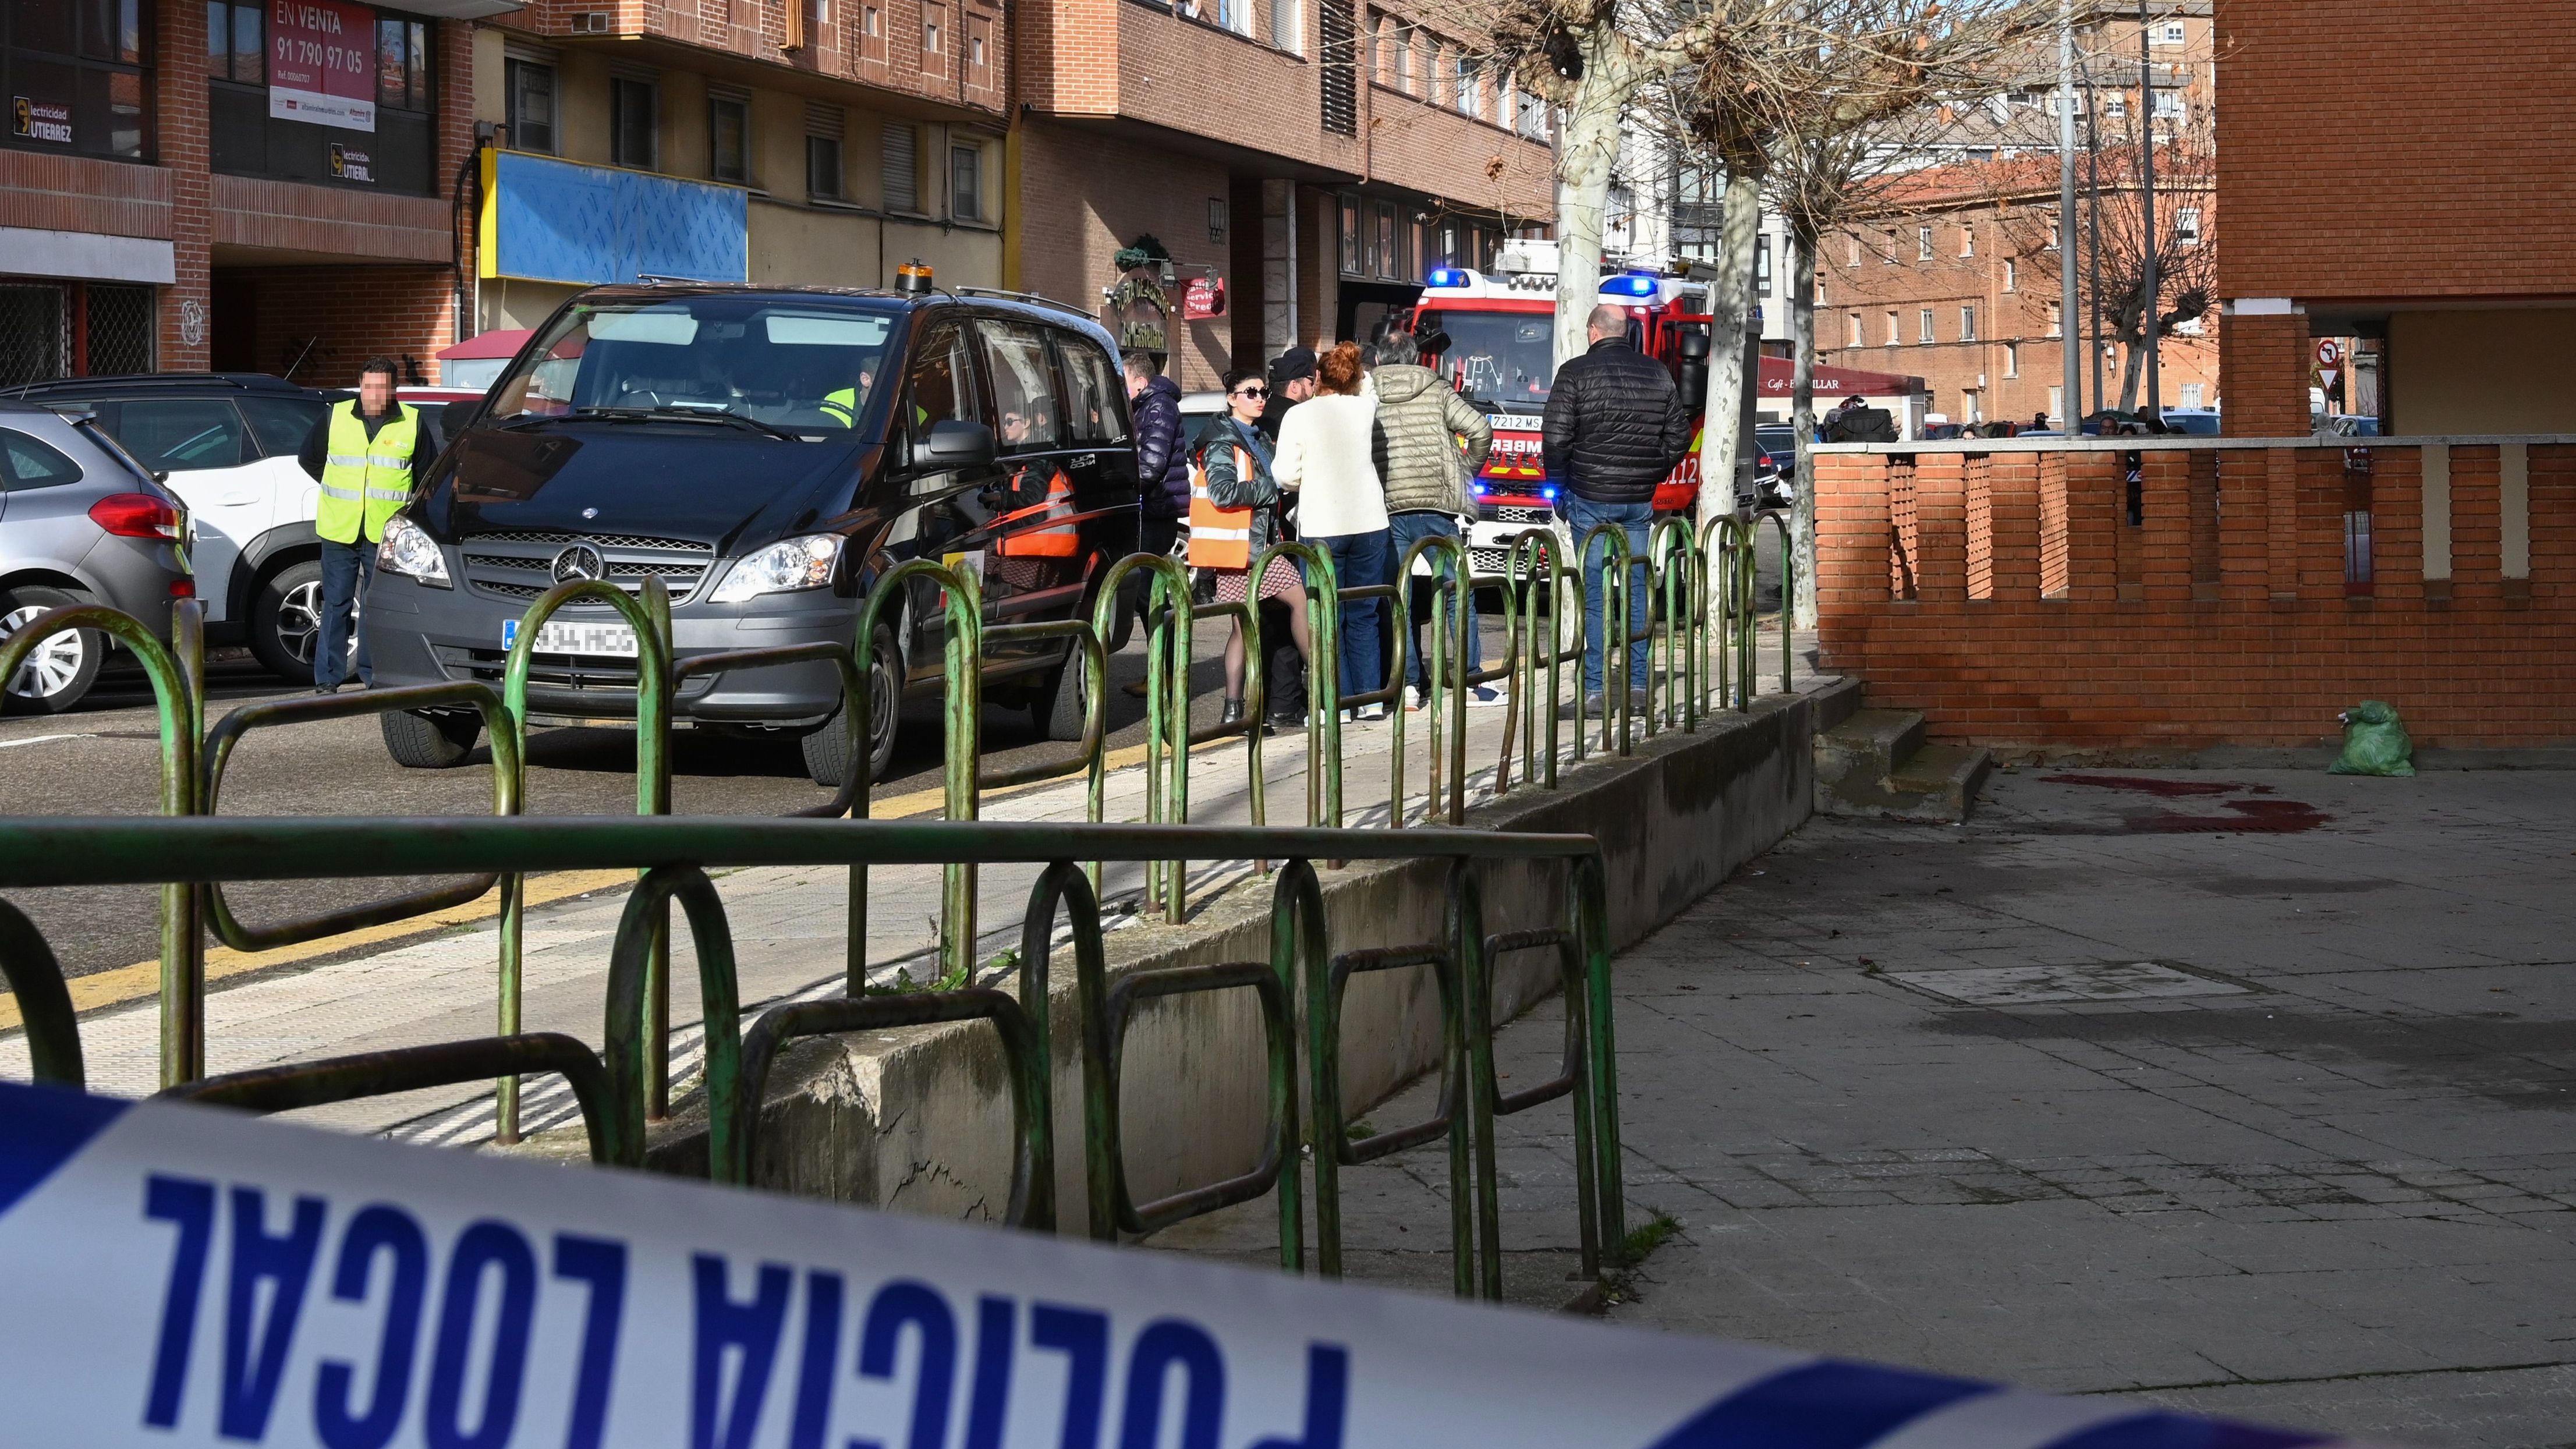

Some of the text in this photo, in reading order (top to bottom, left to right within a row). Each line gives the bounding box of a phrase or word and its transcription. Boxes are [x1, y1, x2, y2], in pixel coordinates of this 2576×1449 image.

[277, 1, 342, 35] EN VENTA
[277, 37, 362, 74] 91 790 97 05
[278, 70, 286, 80] Ref.
[1768, 379, 1784, 391] Café
[1812, 380, 1839, 389] ILLAR
[1494, 416, 1539, 428] 7212 MS
[1661, 458, 1698, 485] 112
[141, 1171, 629, 1449] LOCAL
